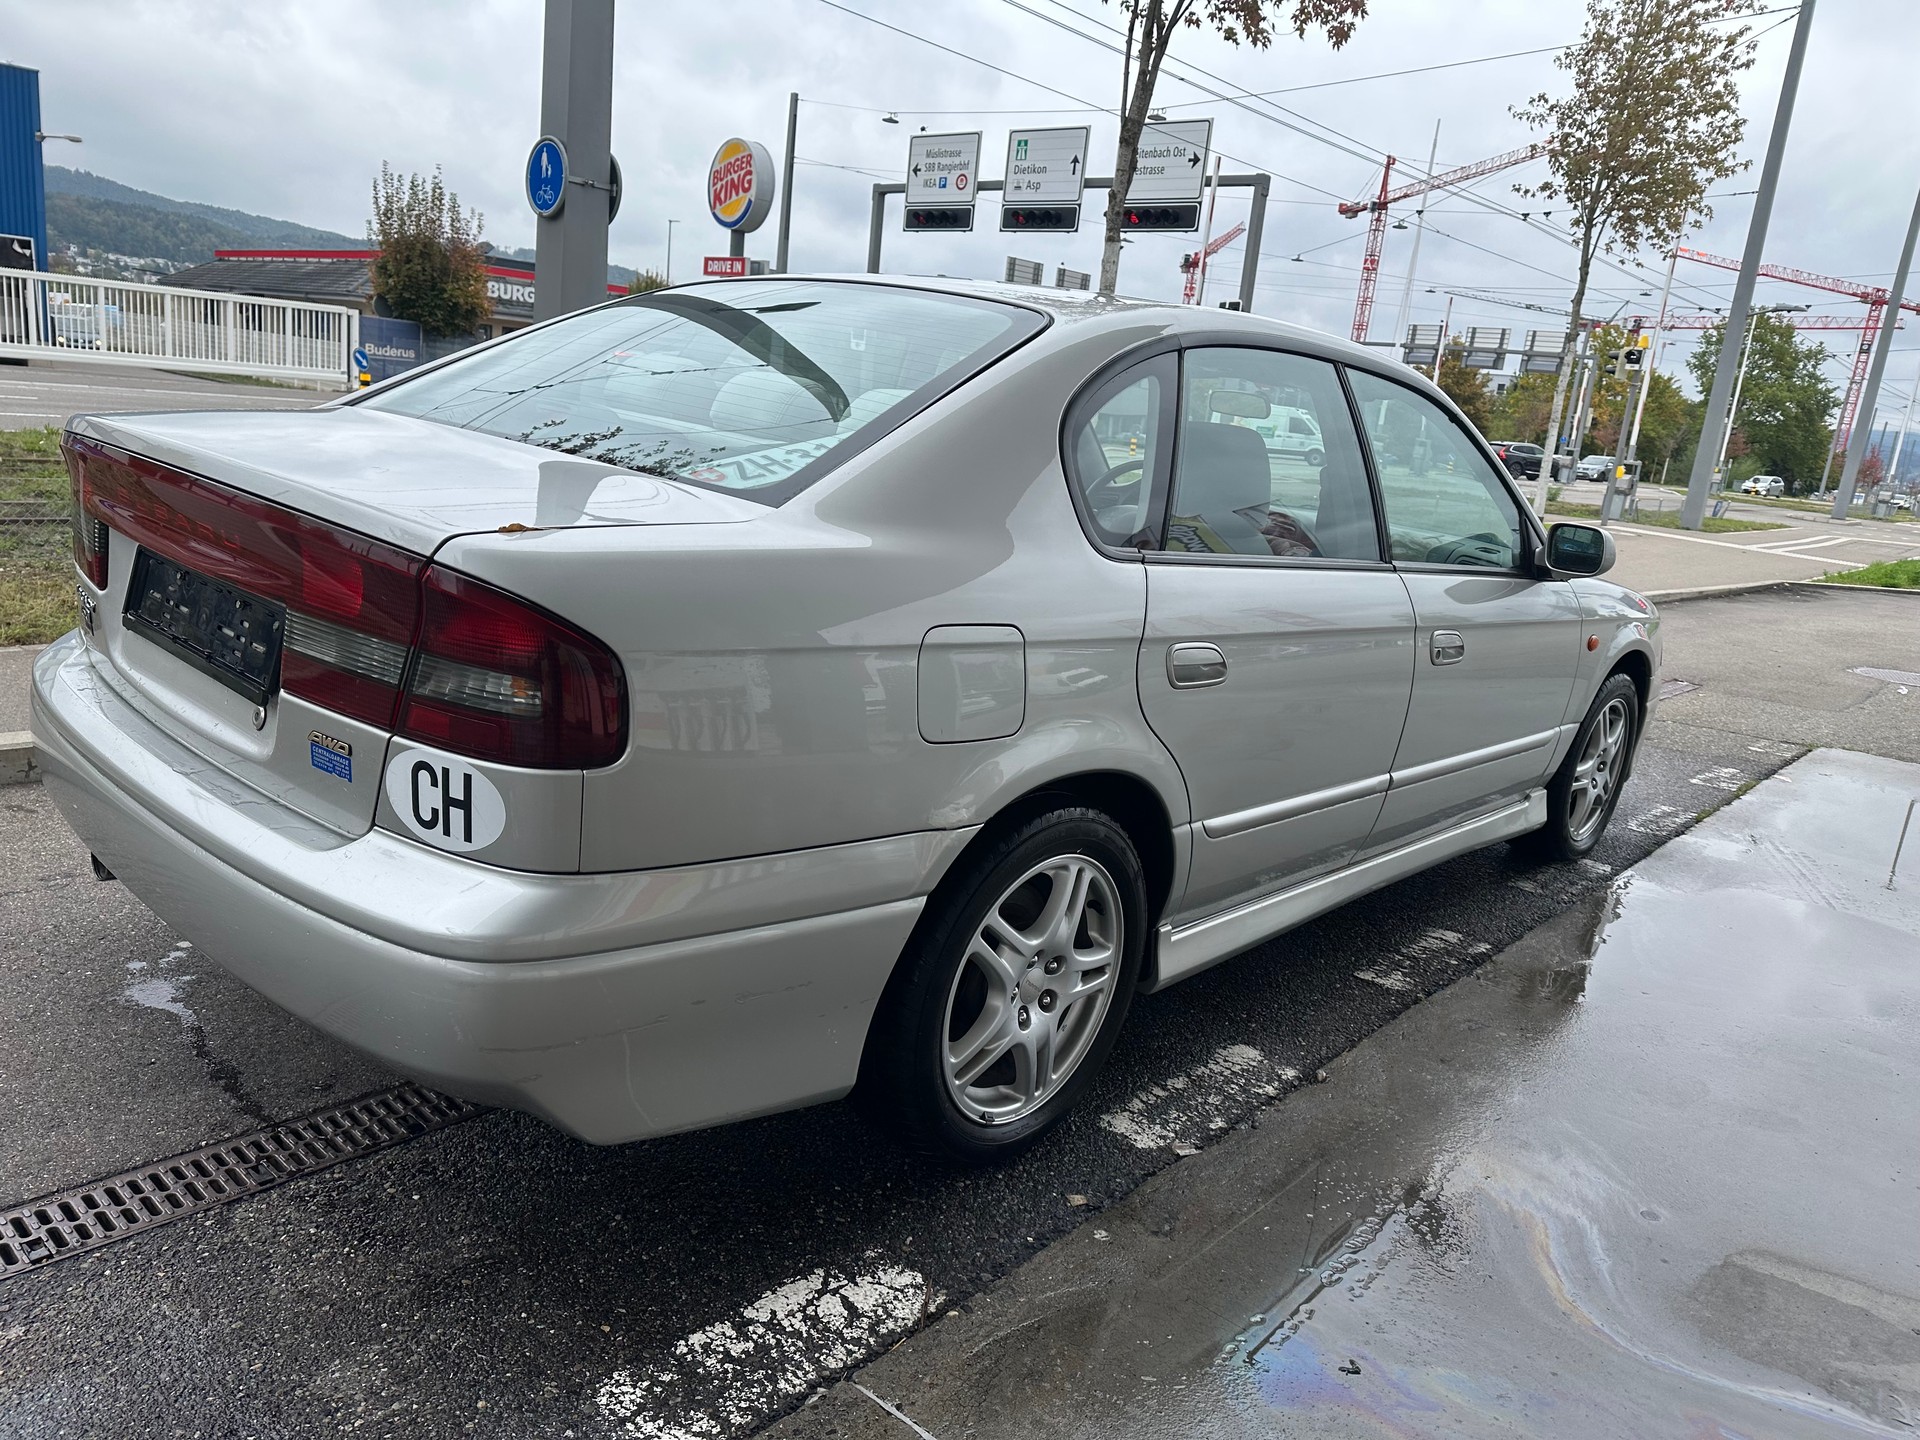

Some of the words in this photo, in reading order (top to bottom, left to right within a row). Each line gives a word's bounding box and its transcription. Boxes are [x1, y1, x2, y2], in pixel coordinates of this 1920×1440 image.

[925, 148, 962, 159] Müslistrasse
[1173, 145, 1187, 158] Ost
[712, 153, 753, 189] BURGER
[924, 162, 936, 173] SBB
[1013, 164, 1047, 175] Dietikon
[923, 178, 937, 188] IKEA
[1025, 179, 1041, 192] Asp
[712, 169, 753, 212] KING
[707, 260, 732, 273] DRIVE
[732, 261, 742, 273] IN
[487, 280, 535, 303] BURG
[364, 343, 416, 359] Buderus
[307, 730, 351, 757] AWD
[411, 760, 473, 844] CH
